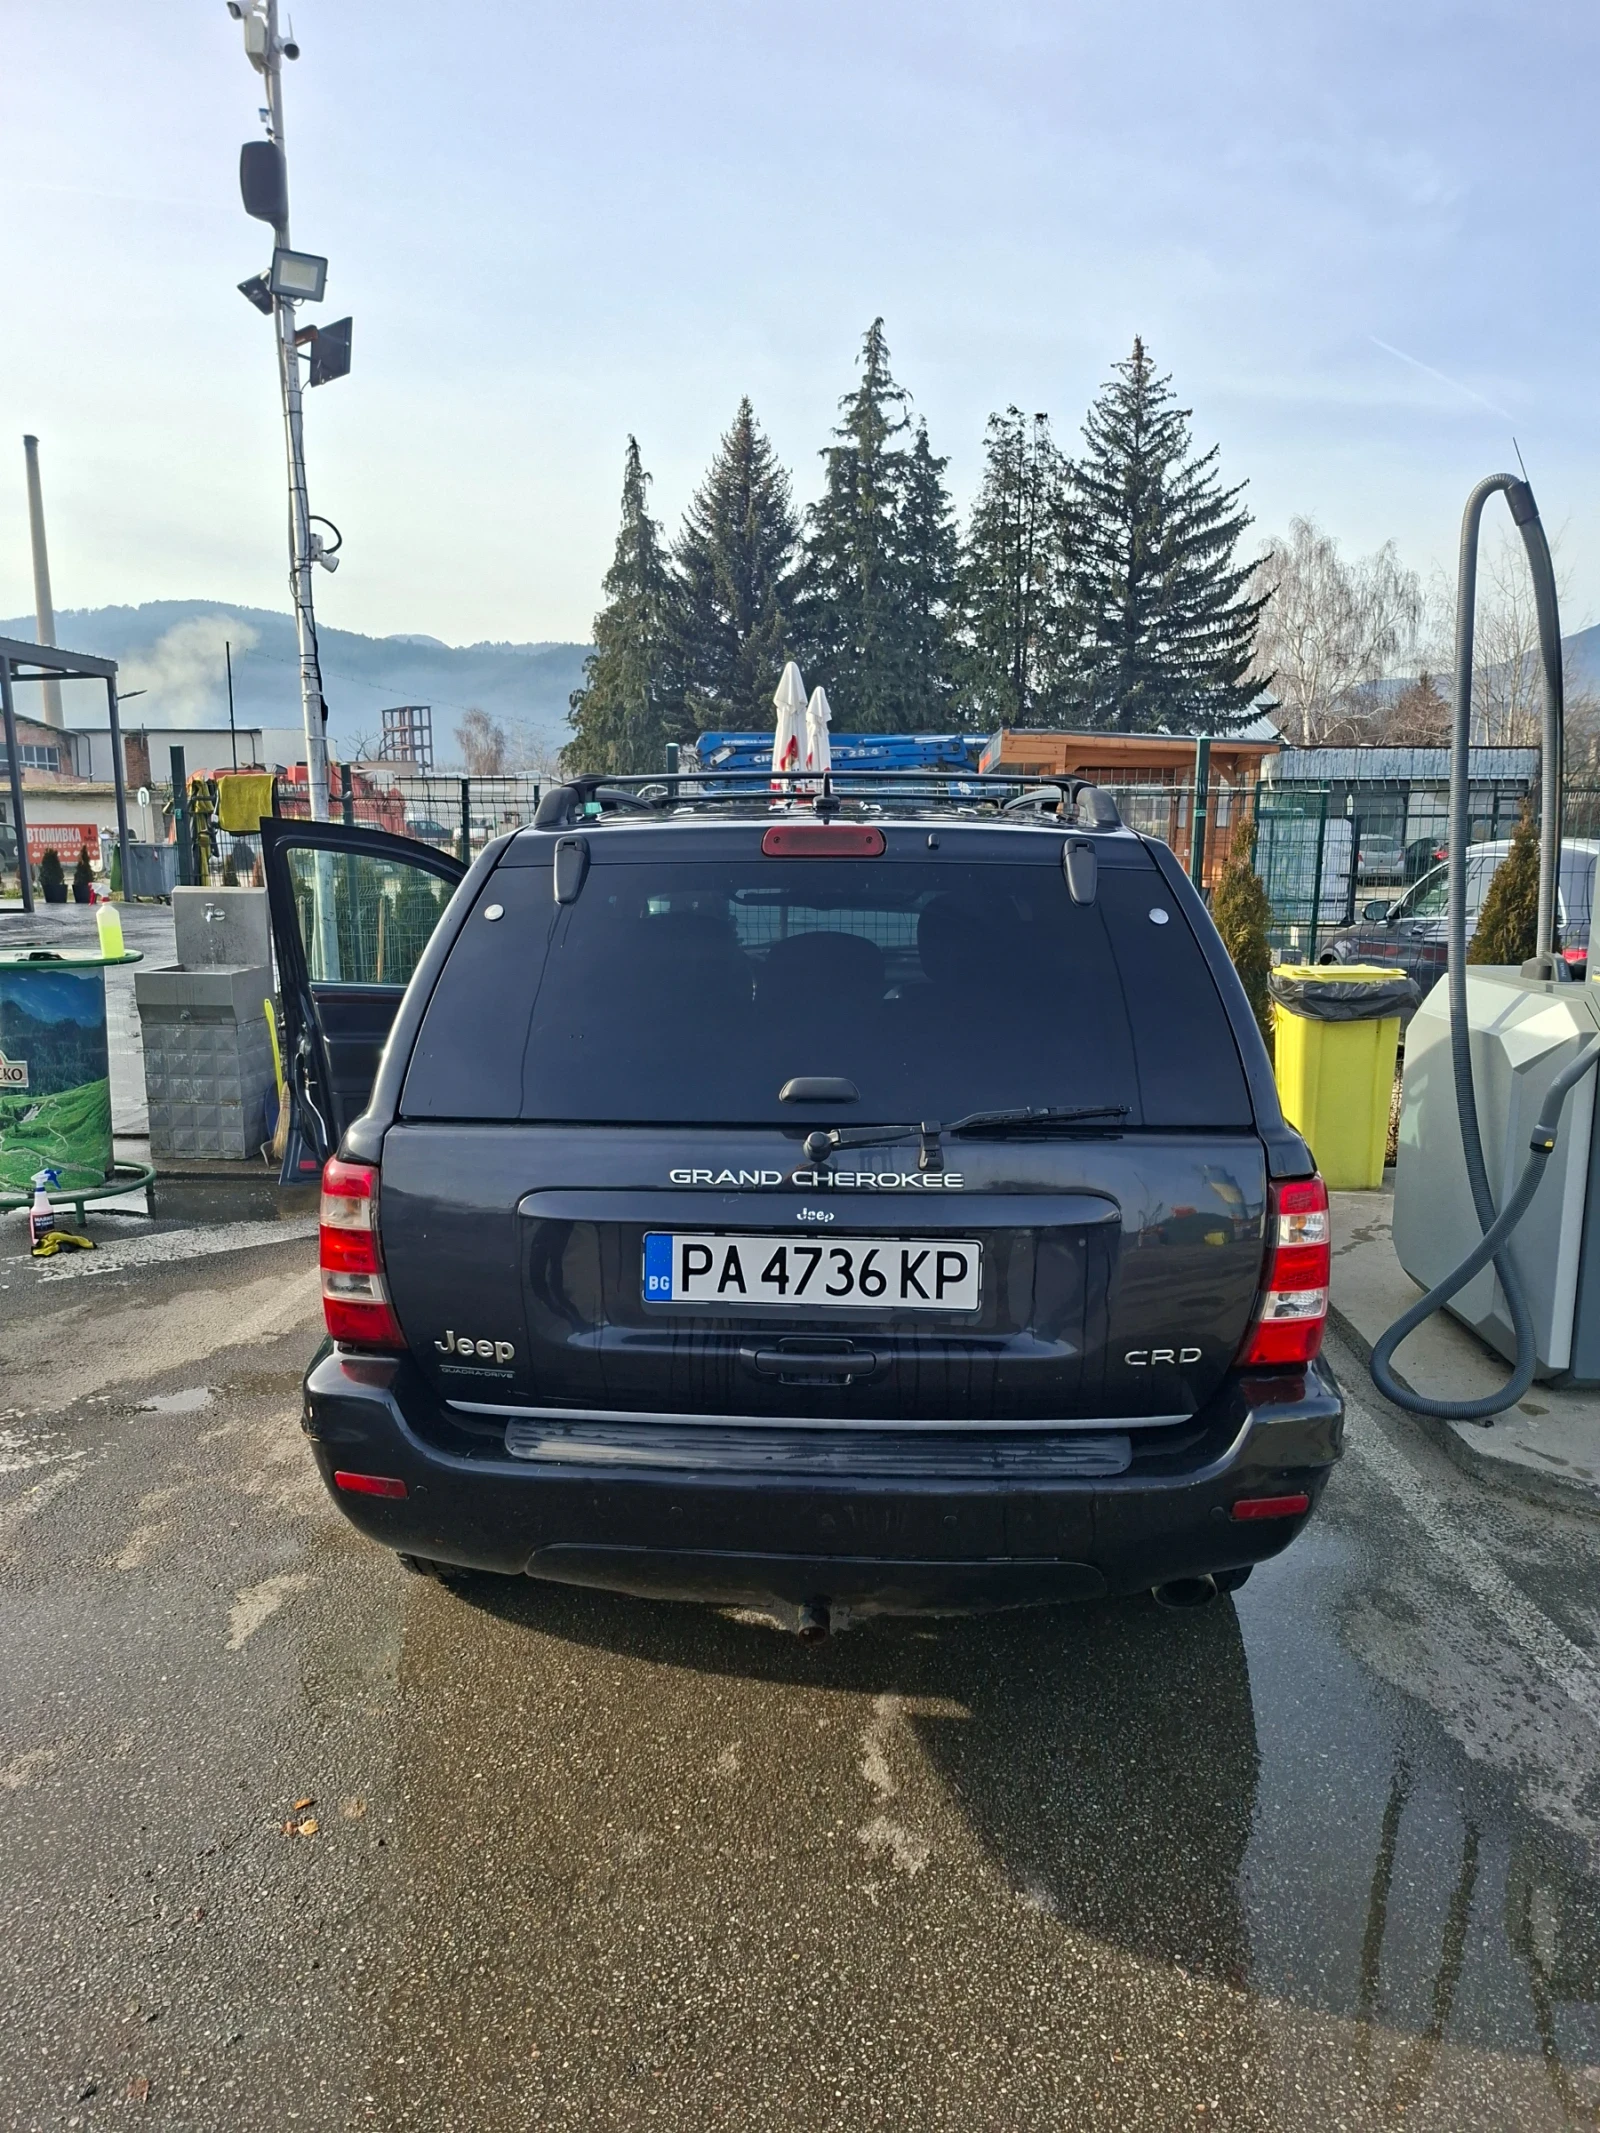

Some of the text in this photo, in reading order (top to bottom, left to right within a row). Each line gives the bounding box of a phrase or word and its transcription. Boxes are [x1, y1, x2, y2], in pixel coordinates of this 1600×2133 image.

[754, 754, 772, 763] CIF
[849, 748, 879, 758] 28.4
[26, 827, 81, 843] ВТОМИВКА
[669, 1168, 965, 1189] GRAND CHEROKEE
[796, 1207, 835, 1224] Jeep
[681, 1243, 968, 1301] PA 4736 KP
[649, 1275, 670, 1291] BG
[434, 1330, 515, 1364] Jeep
[1124, 1347, 1203, 1367] CRD
[441, 1368, 514, 1379] QUADRA-DRIVE
